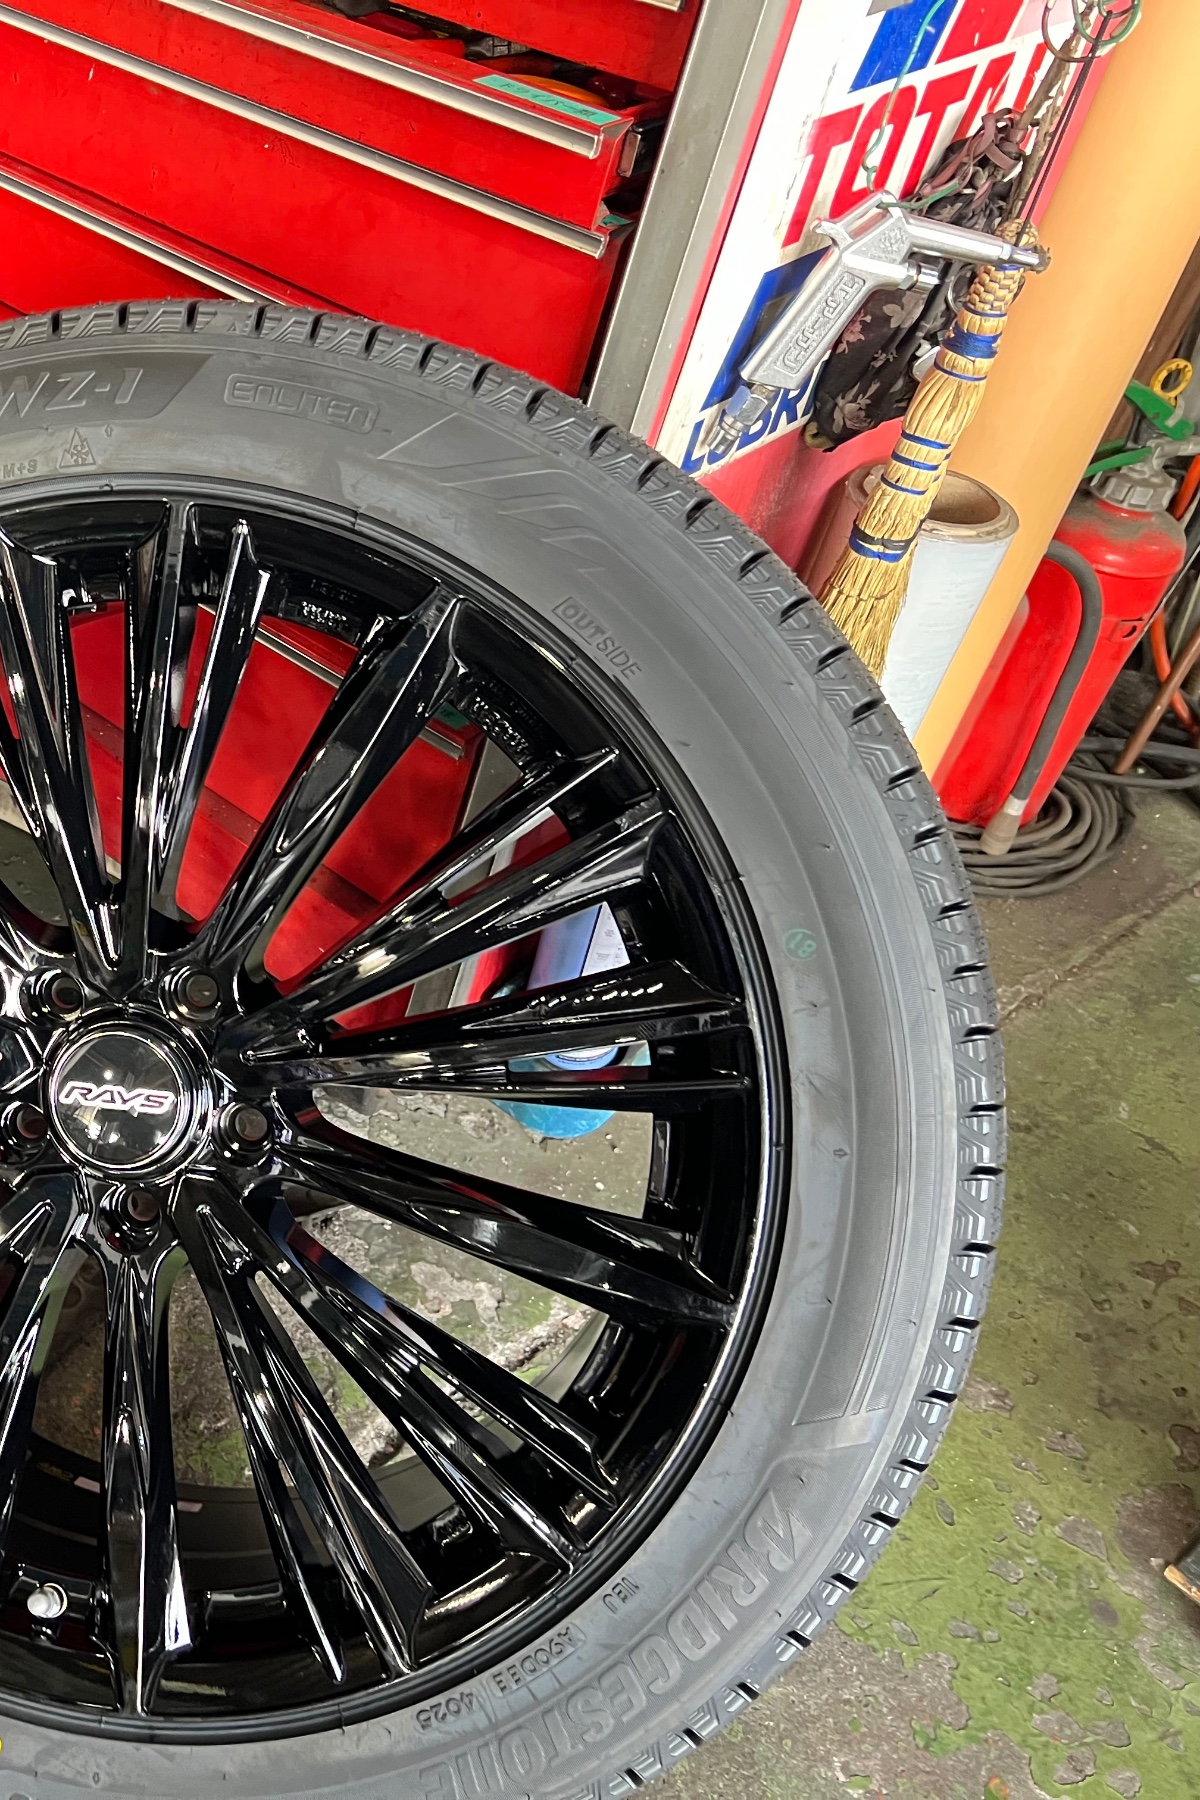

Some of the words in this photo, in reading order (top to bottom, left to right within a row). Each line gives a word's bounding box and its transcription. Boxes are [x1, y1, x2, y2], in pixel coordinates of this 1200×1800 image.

[230, 378, 374, 428] ENLITEN
[1, 458, 38, 480] M+S
[557, 600, 642, 681] OUTSIDE
[59, 1081, 174, 1115] RAYS
[414, 1688, 481, 1732] 4025
